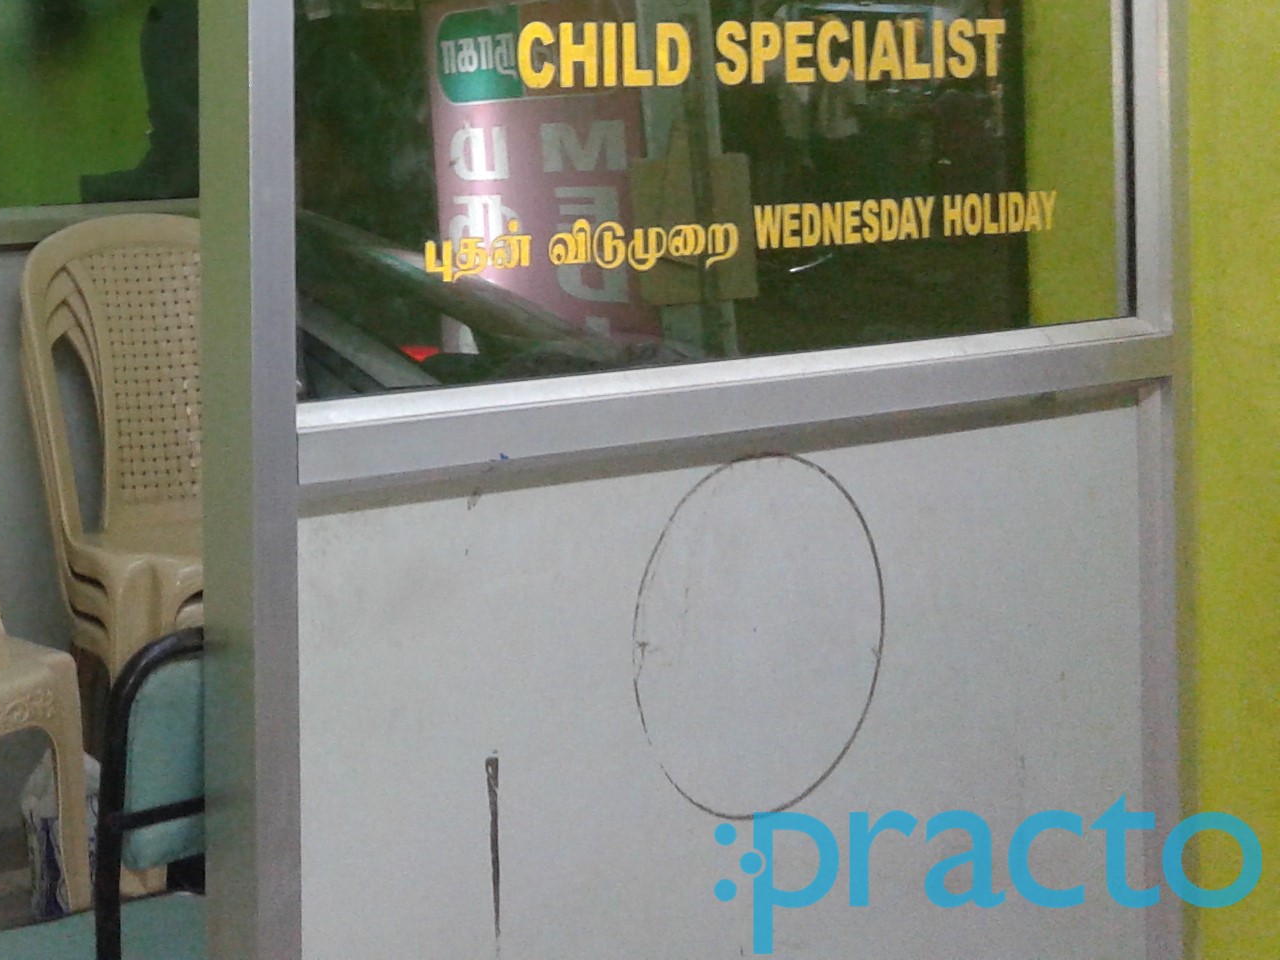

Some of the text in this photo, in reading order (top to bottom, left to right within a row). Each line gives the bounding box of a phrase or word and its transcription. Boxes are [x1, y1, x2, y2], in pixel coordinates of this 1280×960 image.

[517, 21, 692, 88] CHILD
[714, 18, 1007, 86] SPECIALIST
[424, 218, 738, 283] புதன் விடுமுறை
[754, 190, 1059, 250] WEDNESDAY HOLIDAY
